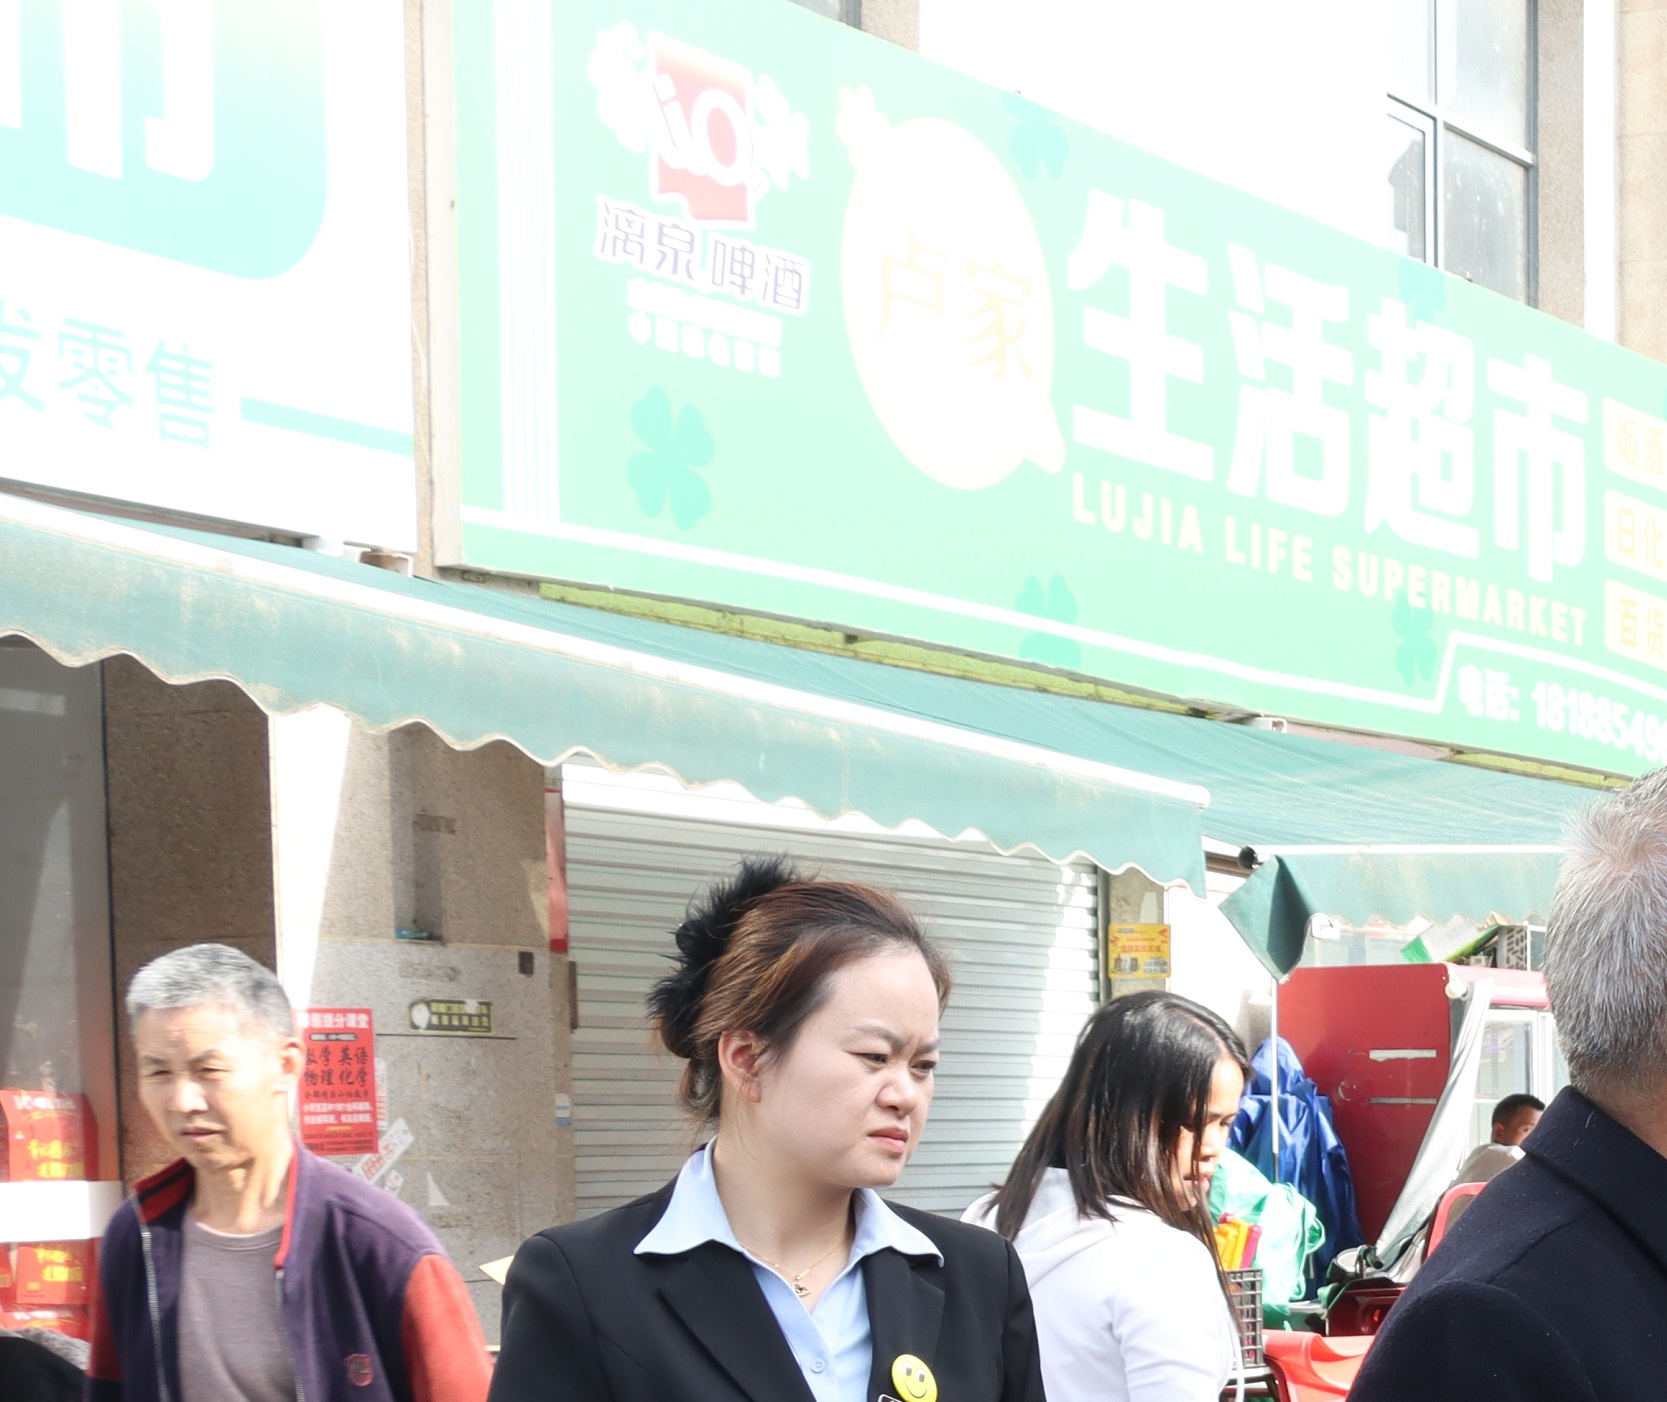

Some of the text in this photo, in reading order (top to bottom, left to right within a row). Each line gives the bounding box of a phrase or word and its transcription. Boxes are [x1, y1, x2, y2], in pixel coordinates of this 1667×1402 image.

[600, 202, 803, 310] 漓泉啤酒
[878, 230, 1034, 384] 卢家
[1068, 187, 1588, 584] 生活超市
[1071, 473, 1588, 647] LUJIA LIFE SUPERMARKET
[1617, 506, 1664, 569] 日化
[1617, 596, 1664, 660] 百货
